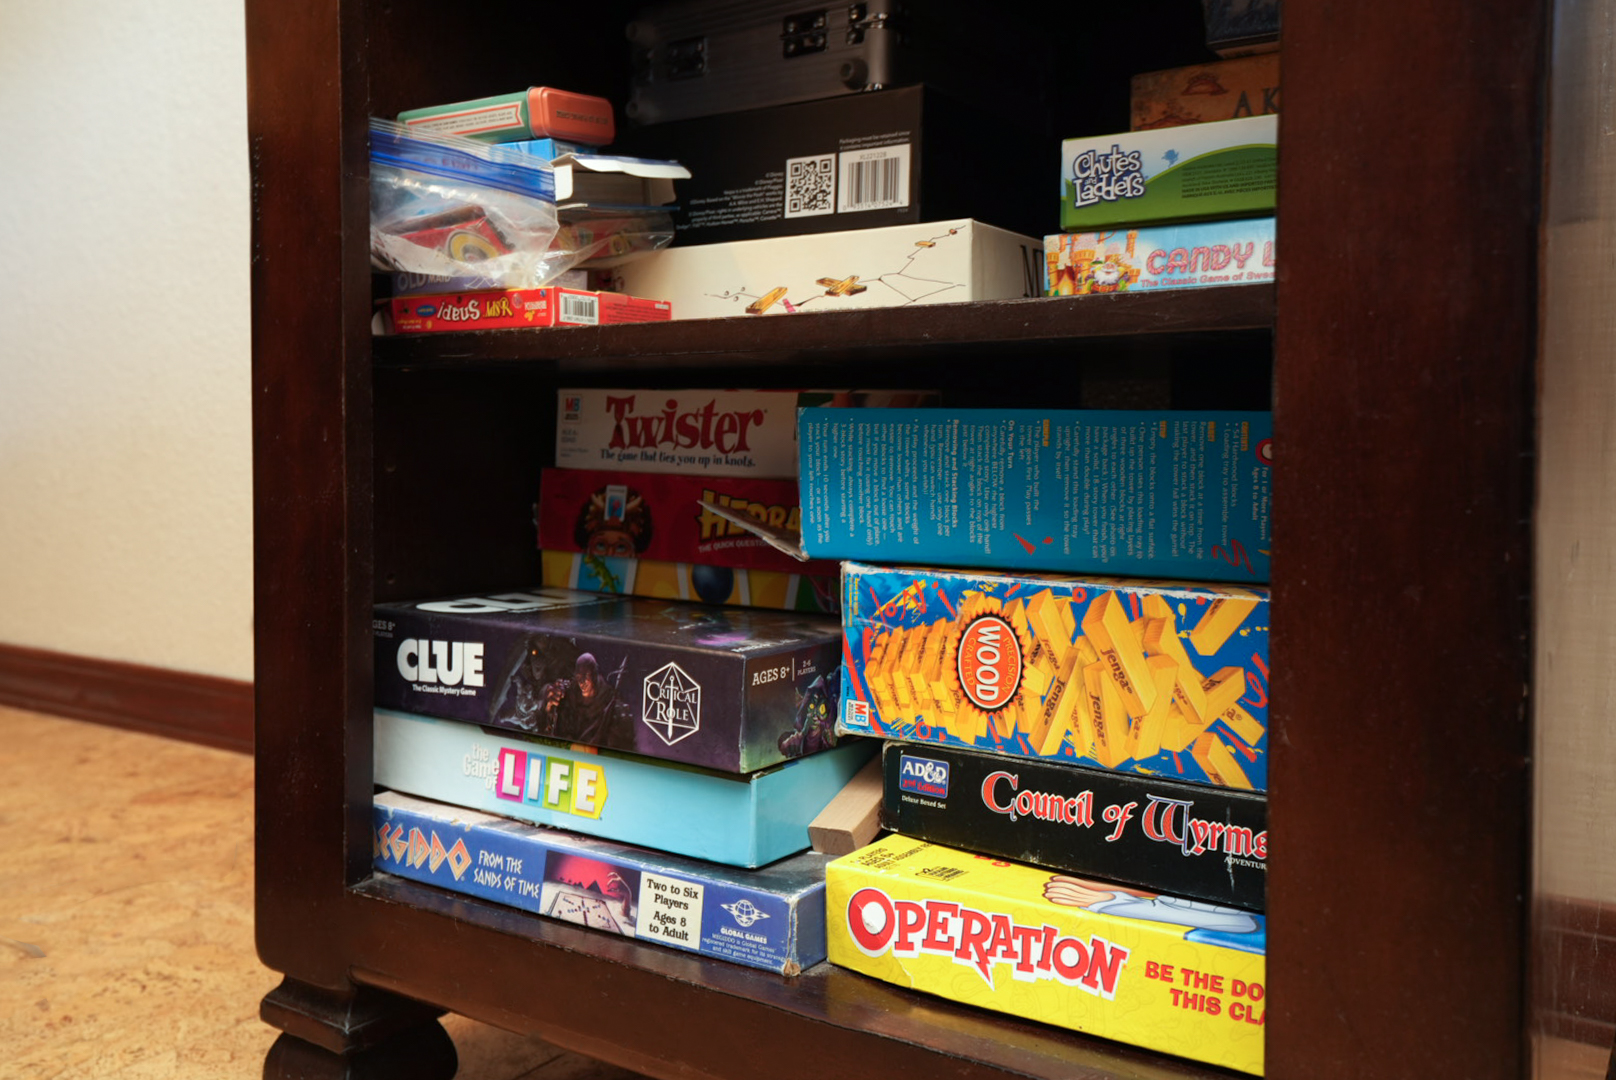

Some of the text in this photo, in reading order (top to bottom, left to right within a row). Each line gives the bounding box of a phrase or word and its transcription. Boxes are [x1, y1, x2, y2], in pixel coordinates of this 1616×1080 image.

[1233, 86, 1280, 118] AK
[1073, 145, 1142, 178] Chutes
[1073, 172, 1145, 208] Ladders
[1084, 177, 1097, 186] and
[1146, 241, 1275, 276] CANDY L
[1141, 271, 1275, 287] The Classic Game of Swee
[437, 300, 480, 321] Snap!
[605, 394, 763, 454] Twister
[951, 420, 959, 455] Removing
[1148, 428, 1157, 449] Empty
[1222, 429, 1230, 459] Loading
[600, 449, 616, 459] The
[617, 451, 637, 462] game
[640, 451, 656, 462] that
[659, 451, 676, 463] ties
[676, 454, 696, 466] you
[699, 456, 711, 468] up
[713, 454, 723, 465] in
[725, 454, 756, 467] knots.
[1231, 442, 1239, 481] Hardwood
[1252, 467, 1260, 483] Ages
[950, 473, 958, 503] Stacking
[1230, 484, 1238, 507] blocks
[1221, 488, 1229, 522] assemble
[1259, 516, 1268, 540] Players
[713, 541, 735, 551] QUICK
[372, 619, 387, 630] GES
[396, 638, 485, 687] CLUE
[797, 665, 817, 676] PLAYERS
[963, 637, 977, 687] CRAFTED
[975, 624, 1001, 702] WOOD
[1001, 636, 1018, 694] PRECISION
[751, 665, 791, 686] AGES 8+
[412, 683, 476, 697] The Classic Mystery Game
[855, 703, 867, 723] MB
[471, 743, 489, 760] the
[463, 754, 499, 779] Game
[902, 760, 947, 783] AD&D
[485, 775, 498, 792] of
[500, 751, 600, 814] LIFE
[917, 781, 945, 795] Edition
[901, 794, 947, 810] Deluxe Boxed Set
[980, 770, 1267, 859] Council of Wyrms
[477, 850, 522, 874] FROM THE
[1223, 856, 1267, 870] ADVENTUR
[473, 869, 540, 898] SANDS OF TIME
[647, 878, 699, 899] Two to Six
[654, 893, 689, 910] Players
[653, 911, 687, 927] Ages 8
[649, 923, 689, 941] to Adult
[720, 926, 768, 944] GLOBAL GAMES
[848, 887, 1129, 996] OPERATION
[702, 937, 725, 948] registered
[726, 942, 751, 953] trademark
[722, 947, 732, 955] skill
[733, 951, 747, 959] game
[741, 940, 757, 949] Global
[1144, 960, 1265, 1002] BE THE DO
[1169, 987, 1222, 1016] THIS
